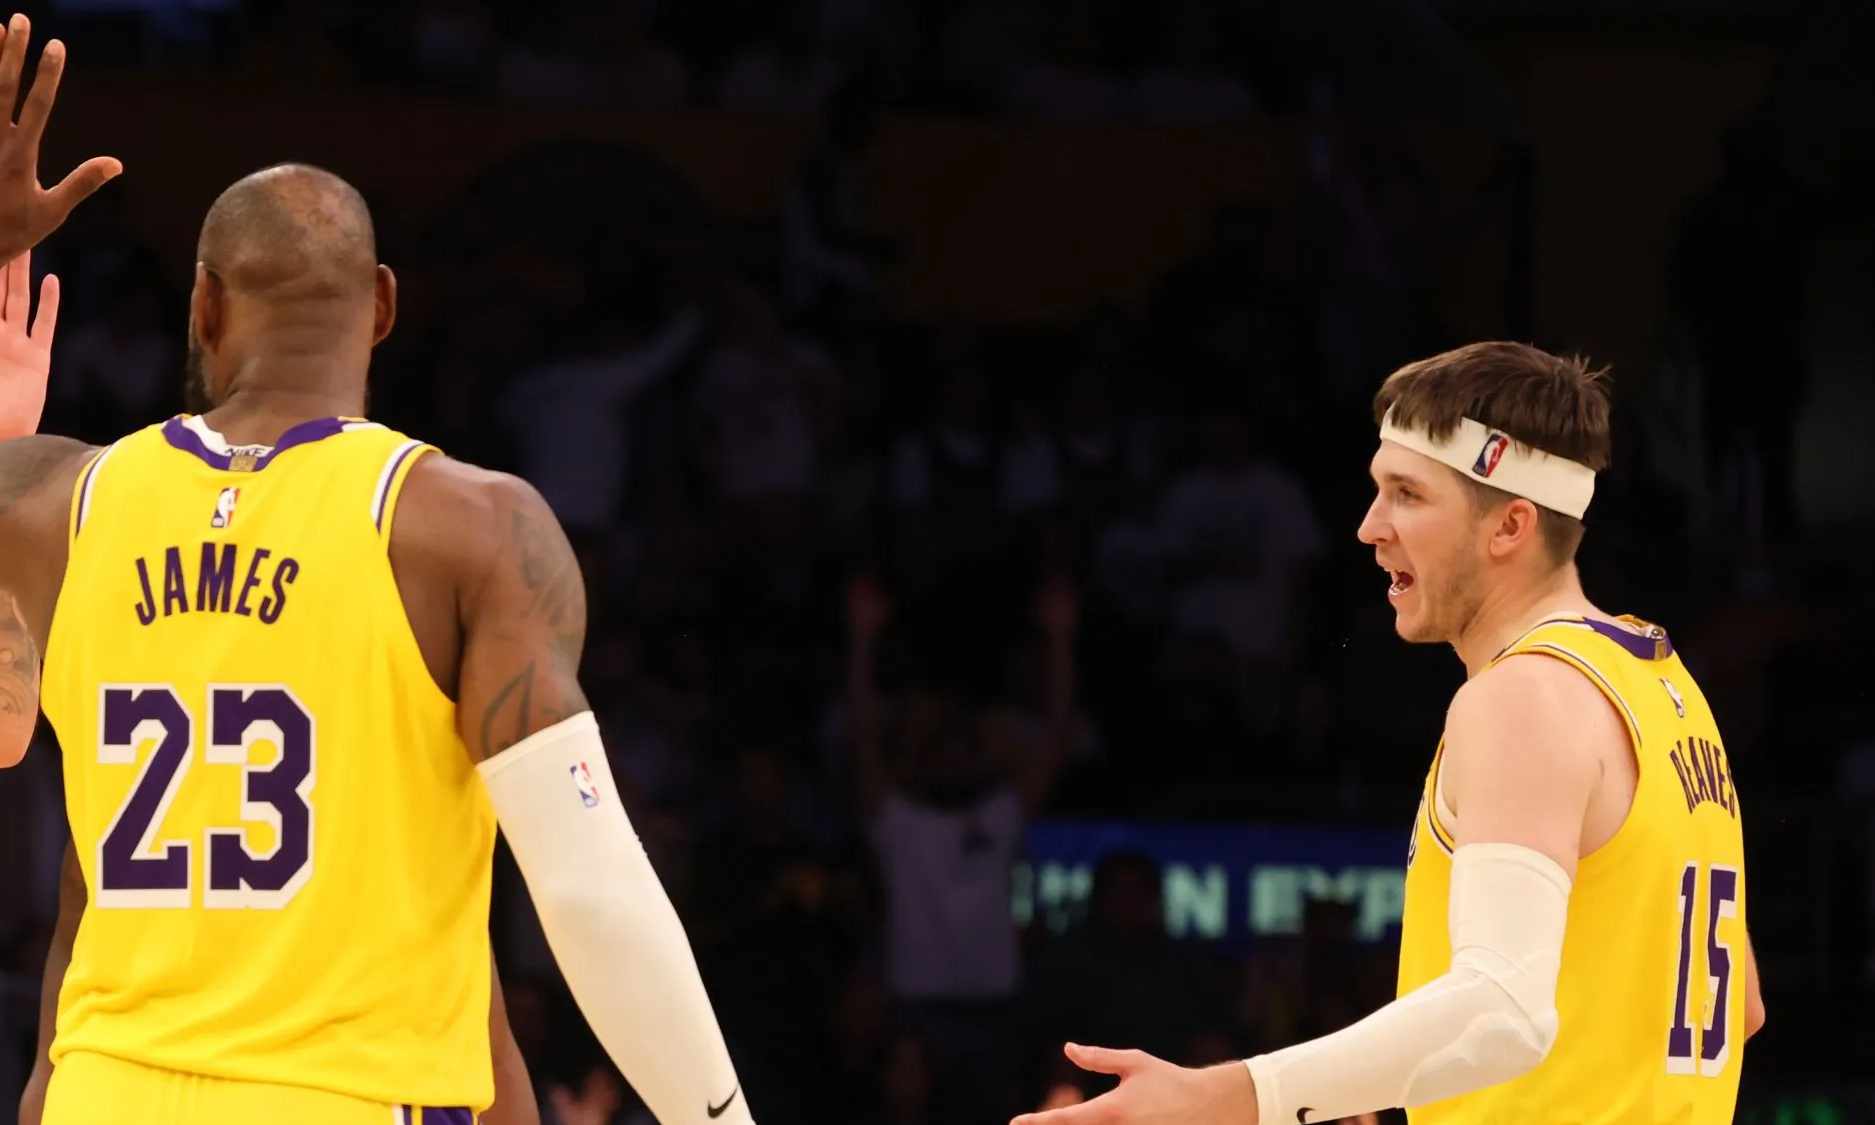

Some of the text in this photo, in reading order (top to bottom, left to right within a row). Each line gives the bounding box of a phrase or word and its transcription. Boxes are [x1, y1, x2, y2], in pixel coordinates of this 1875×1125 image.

[135, 542, 300, 626] JAMES
[96, 682, 317, 910] 23
[1666, 860, 1739, 1078] 15
